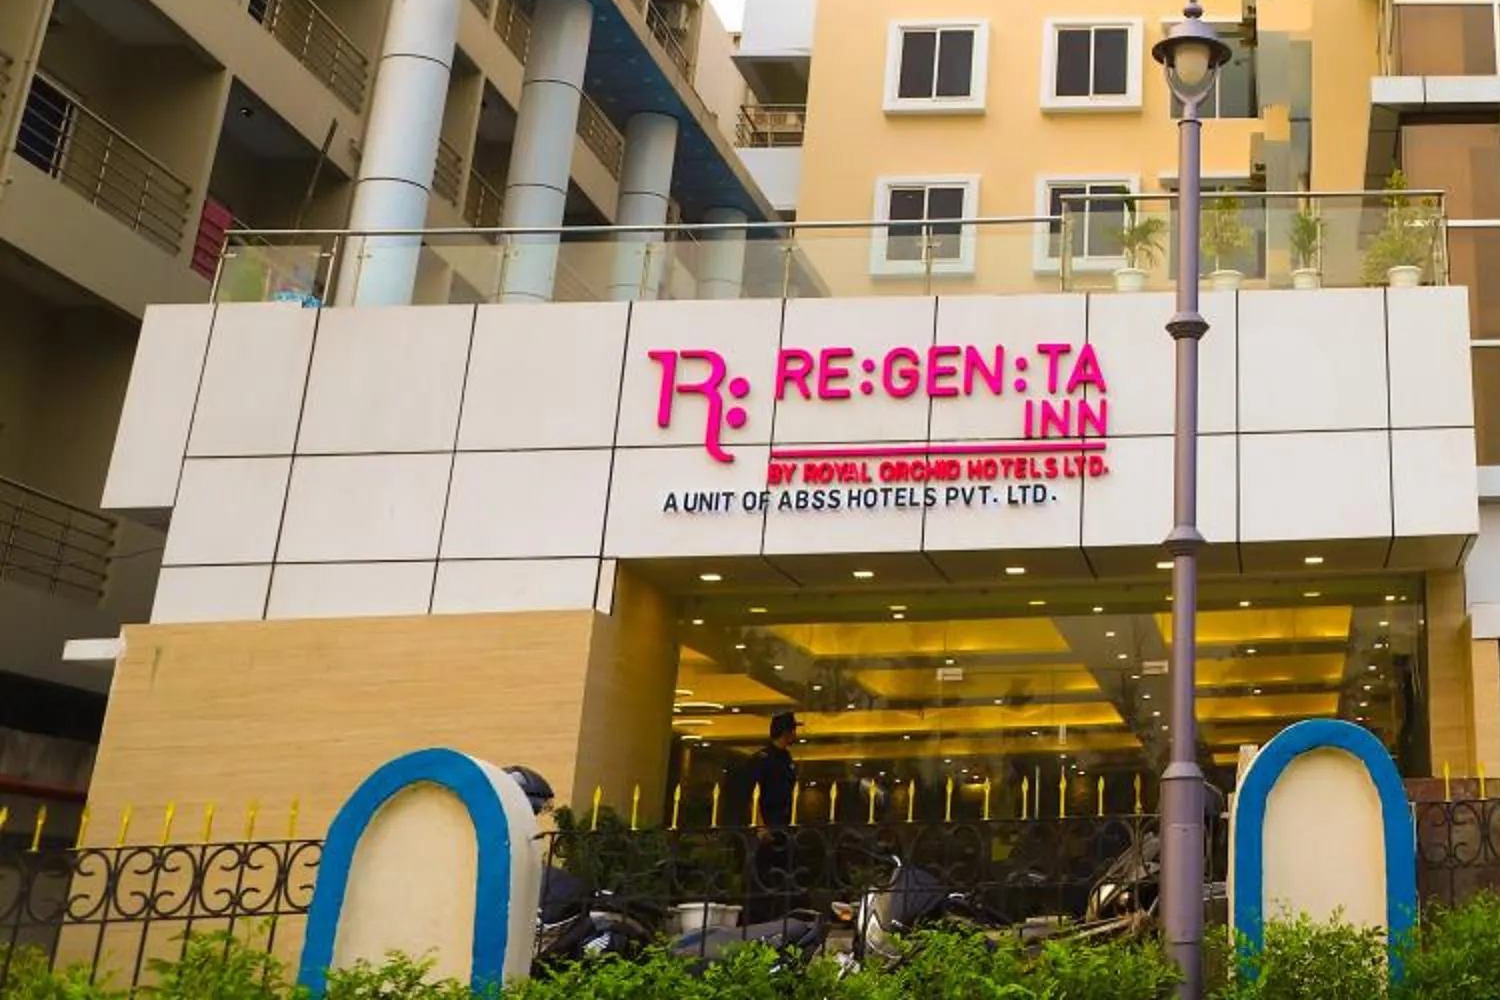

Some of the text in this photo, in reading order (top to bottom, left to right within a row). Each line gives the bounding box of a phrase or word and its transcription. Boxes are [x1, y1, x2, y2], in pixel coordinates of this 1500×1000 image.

[1023, 399, 1109, 440] INN
[767, 455, 1109, 486] BY ROYAL ORCHID HOTELS LTD.
[663, 483, 1058, 513] A UNIT OF ABSS HOTELS PVT. LTD.
